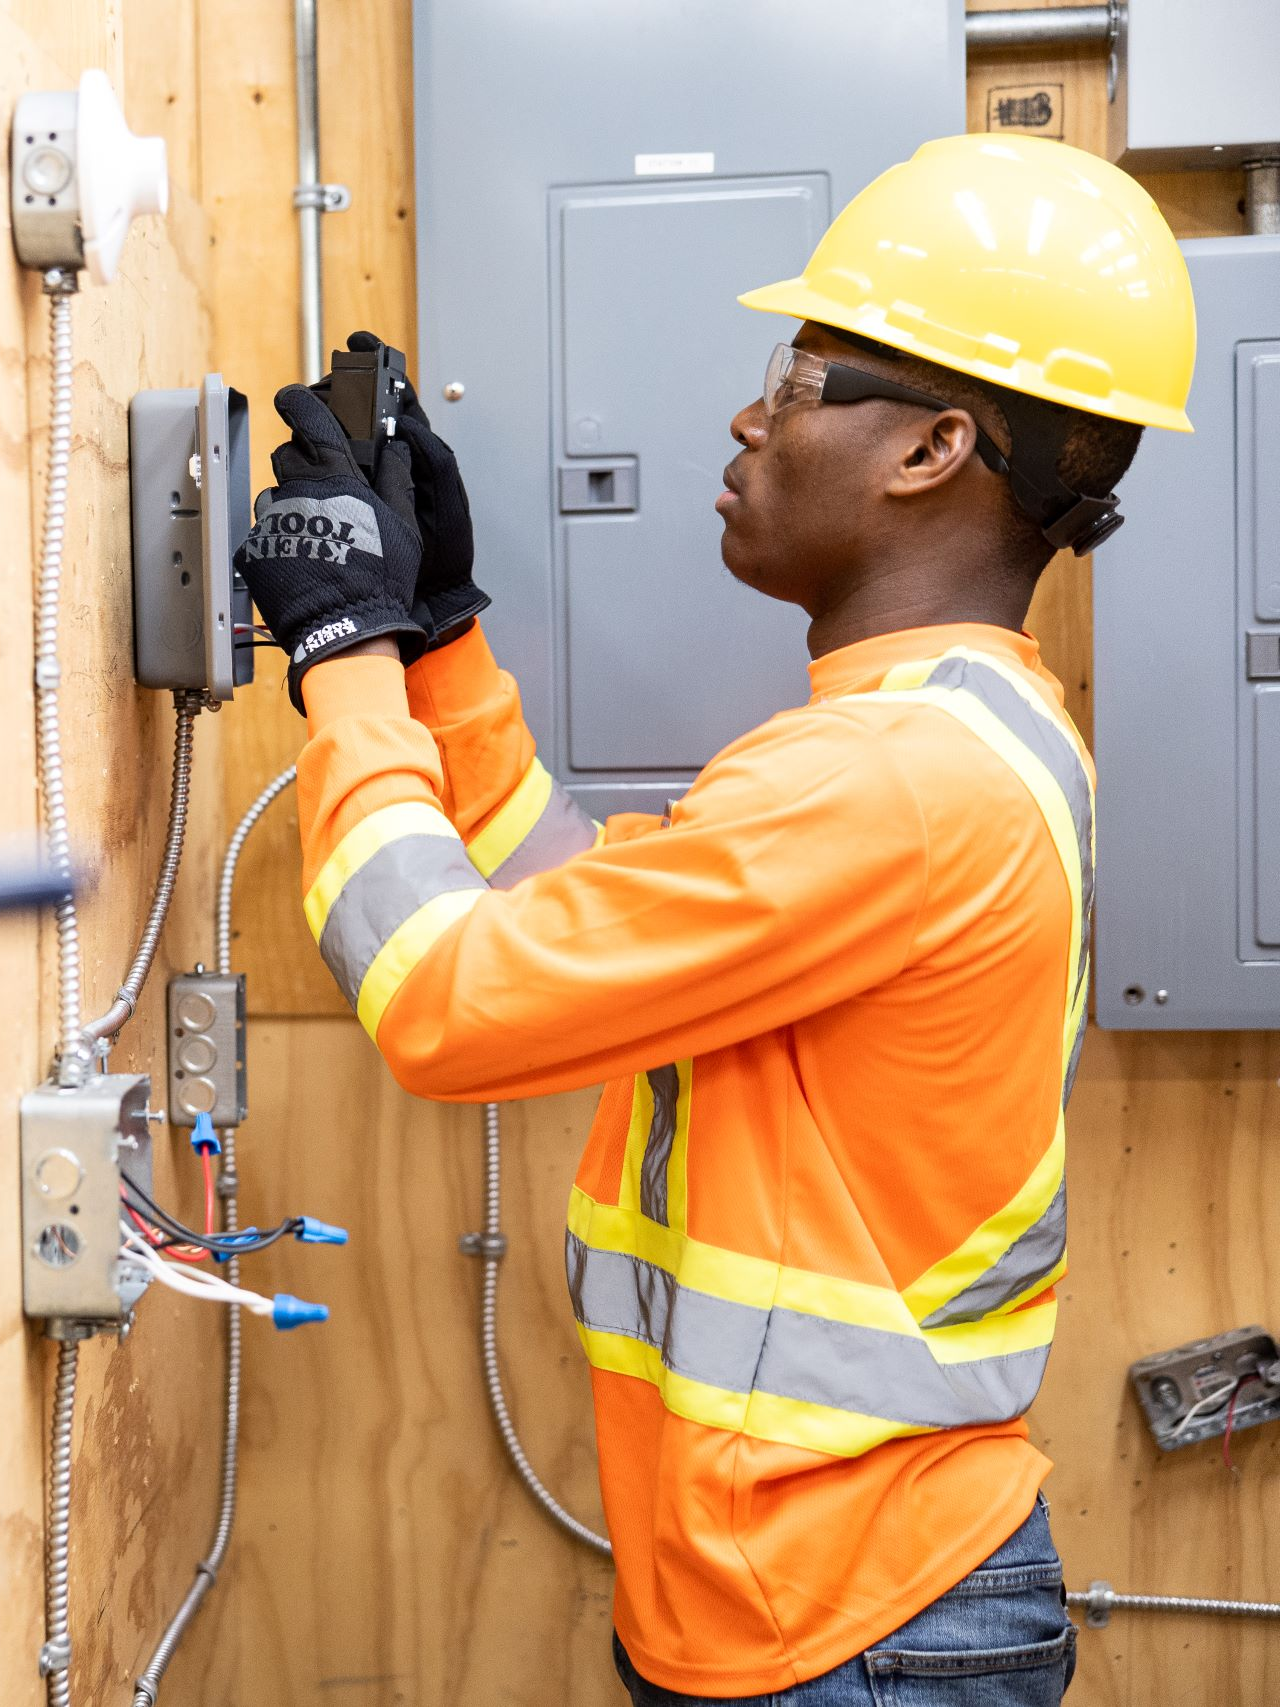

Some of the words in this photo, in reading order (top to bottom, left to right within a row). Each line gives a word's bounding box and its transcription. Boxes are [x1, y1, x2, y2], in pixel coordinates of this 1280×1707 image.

[245, 536, 351, 565] KLEIN
[305, 617, 353, 645] TOOLS
[306, 622, 358, 653] KLEIN
